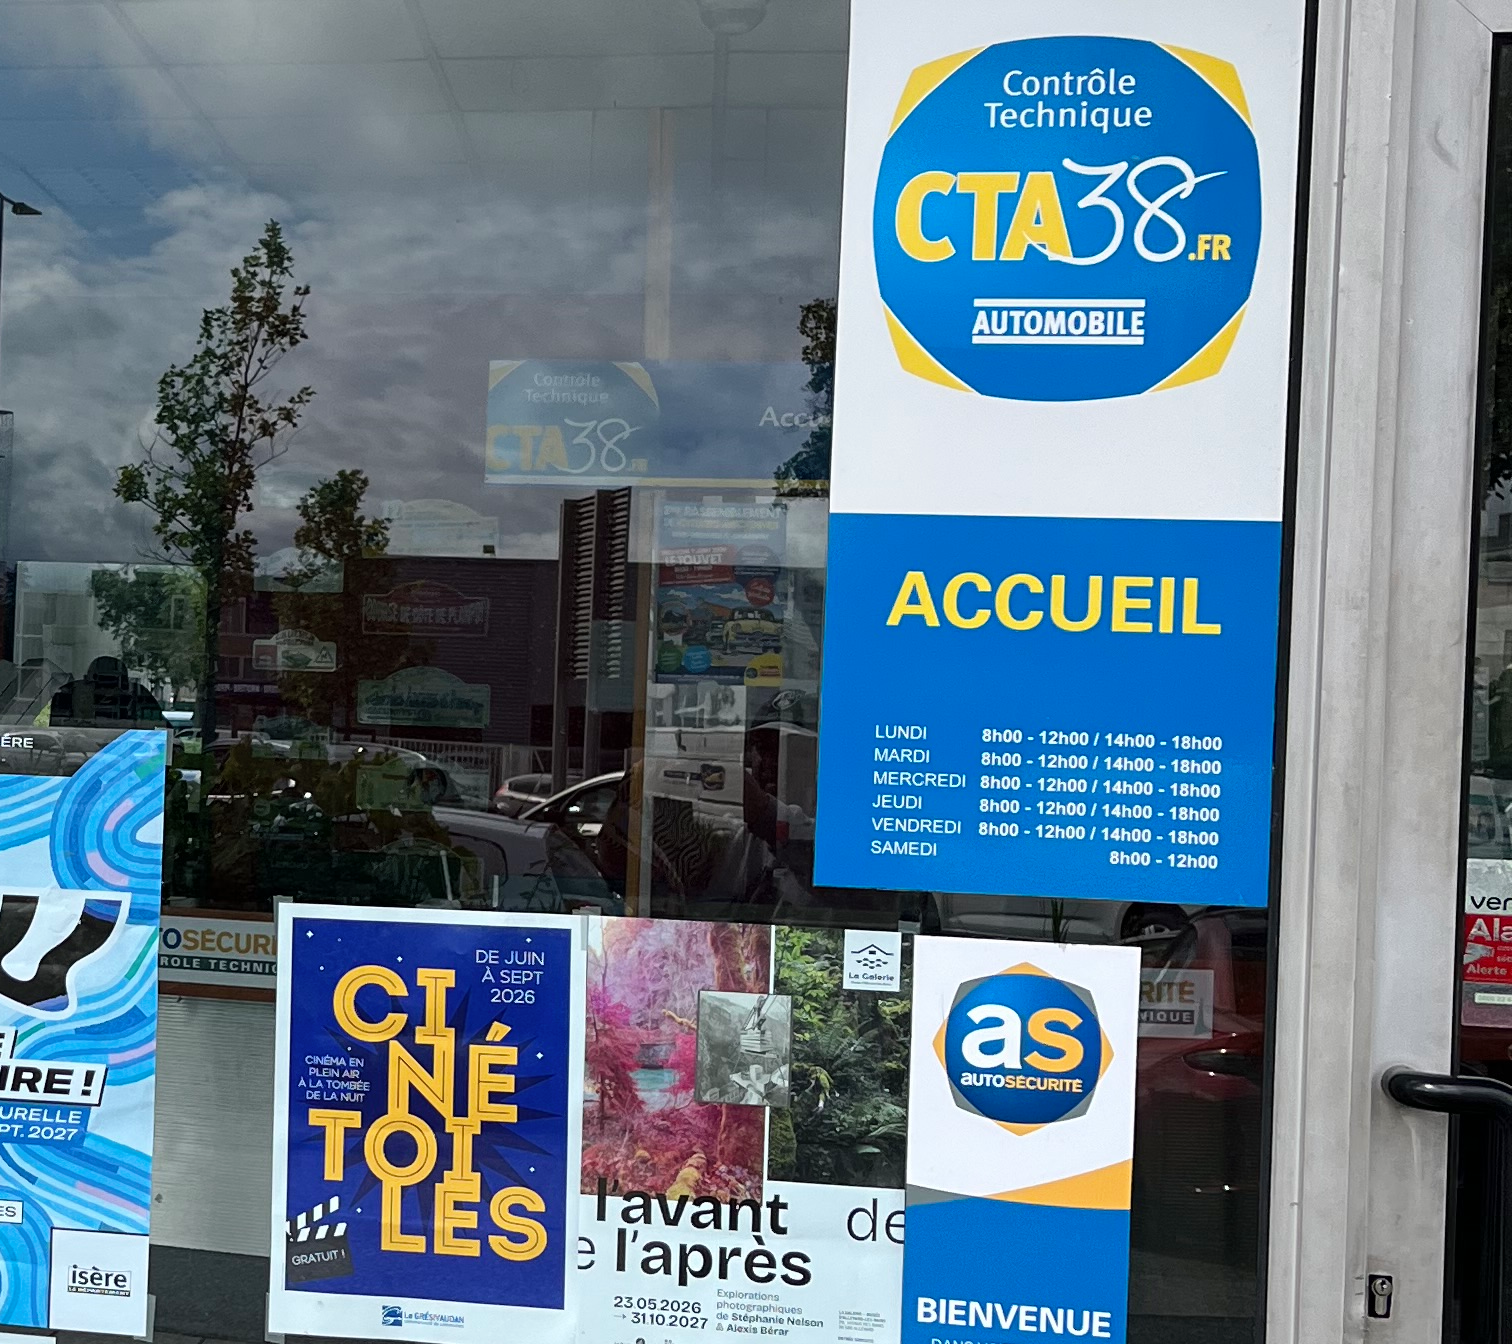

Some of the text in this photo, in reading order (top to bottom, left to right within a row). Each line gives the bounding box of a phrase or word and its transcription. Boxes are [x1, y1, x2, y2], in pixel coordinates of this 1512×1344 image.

[1002, 67, 1136, 97] Contrôle
[984, 102, 1153, 134] Technique
[972, 309, 1145, 336] AUTOMOBILE
[886, 570, 1222, 635] ACCUEIL
[875, 725, 1223, 751] LUNDI 8h00 12h00 14h00 18h00
[874, 748, 1222, 775] MARDI 8h00 12h00 14h00 18h00
[873, 771, 1221, 799] MERCREDI 8h00 12h00 14h00 18h00
[872, 794, 1220, 823] JEUDI 8h00 12h00 14h00 18h00
[871, 817, 1219, 847] VENDREDI 8h00 12h00 14h00 18h00
[870, 840, 1219, 870] SAMEDI 8h00 12h00
[160, 927, 277, 956] OSÉCURI
[475, 949, 545, 967] DE JUIN
[481, 966, 544, 986] À SEPT
[848, 971, 895, 981] La Galerie
[490, 989, 535, 1004] 2026
[961, 1003, 1085, 1073] as
[305, 1054, 364, 1067] CINÉMA EN
[309, 1067, 340, 1078] PLEIN
[306, 1090, 321, 1100] DE
[326, 1079, 370, 1092] TOMBÉE
[28, 1124, 79, 1141] 2027
[596, 1177, 789, 1235] l'avant
[291, 1250, 339, 1266] GRATUIT
[615, 1227, 813, 1287] l'après
[71, 1264, 128, 1289] isère
[613, 1295, 702, 1314] 23.05.2026
[716, 1288, 780, 1302] Explorations
[716, 1300, 803, 1315] photographiques
[716, 1311, 824, 1328] de Stéphanie Nelson
[726, 1323, 758, 1335] Alexis
[916, 1296, 1112, 1338] BIENVENUE
